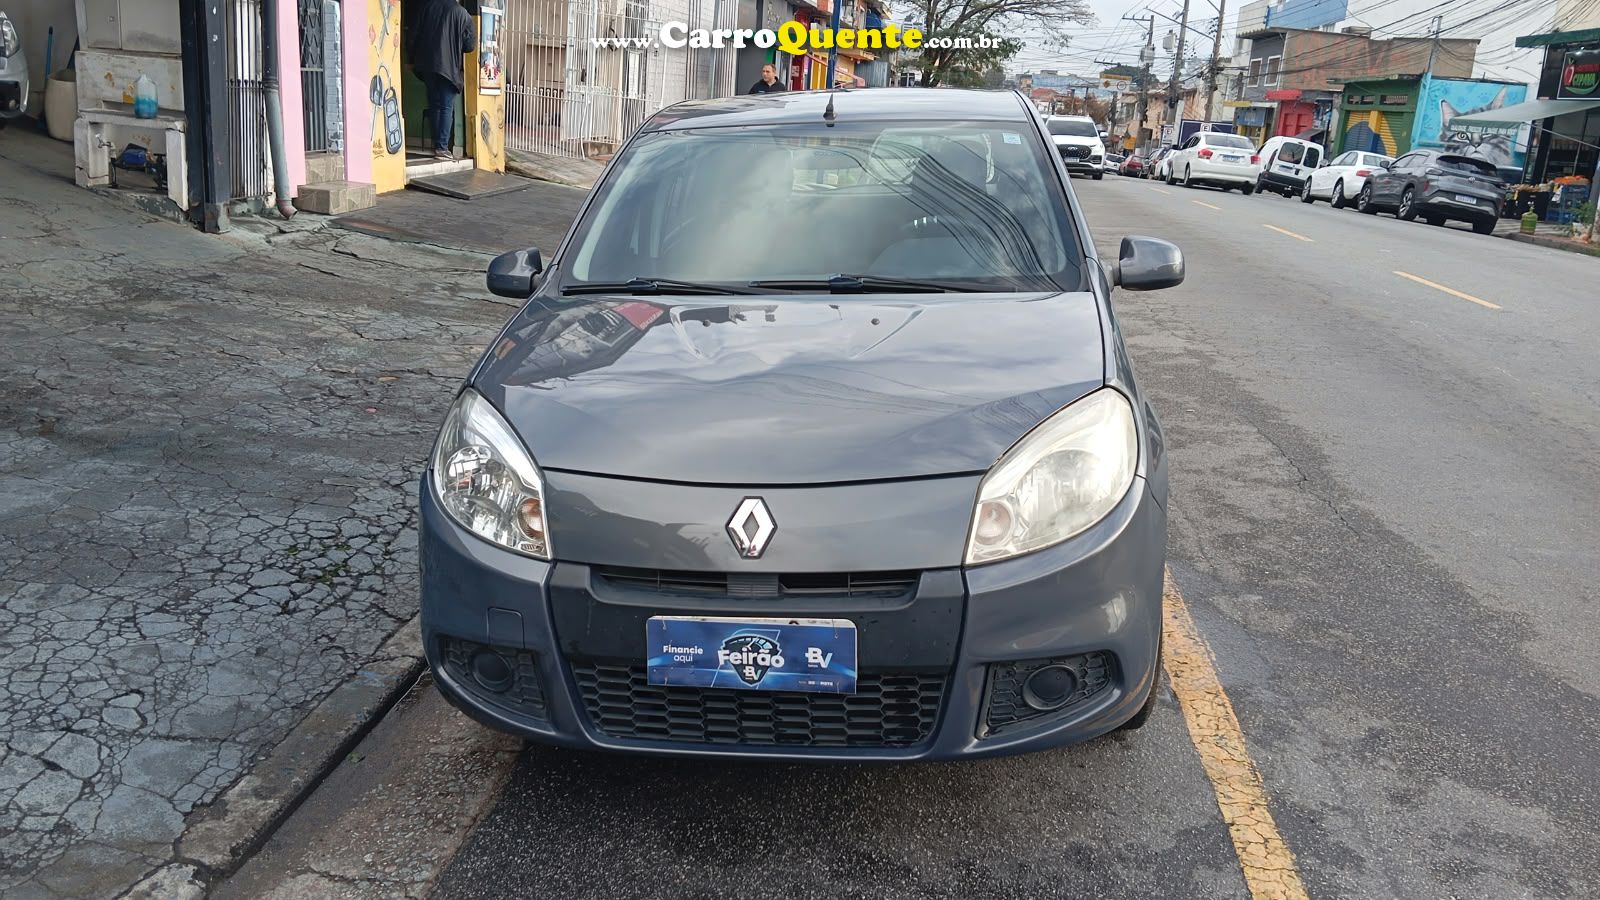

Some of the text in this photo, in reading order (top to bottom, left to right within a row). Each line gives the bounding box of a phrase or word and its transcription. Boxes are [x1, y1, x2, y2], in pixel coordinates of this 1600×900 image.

[663, 645, 703, 655] Financie
[718, 648, 785, 668] Feirão
[805, 647, 833, 669] BV
[673, 654, 693, 663] aqui
[743, 665, 762, 681] BV
